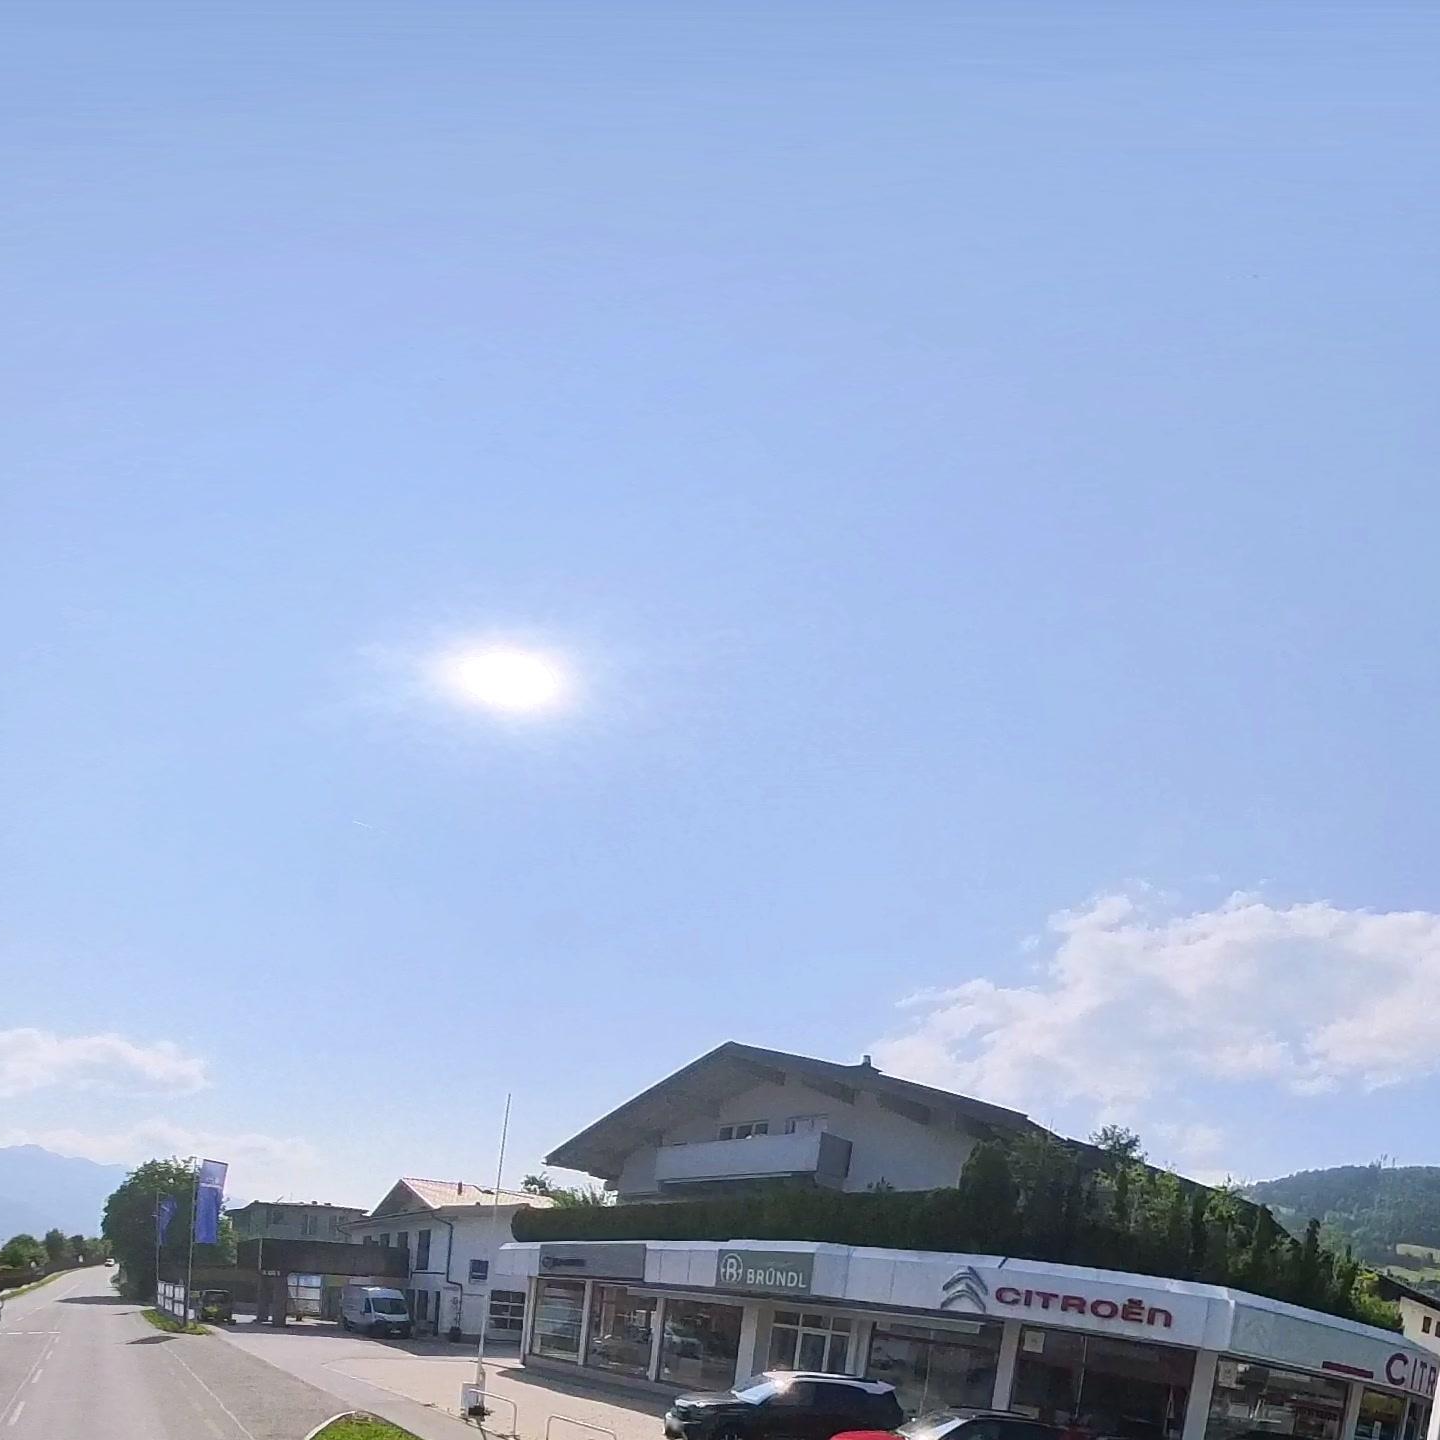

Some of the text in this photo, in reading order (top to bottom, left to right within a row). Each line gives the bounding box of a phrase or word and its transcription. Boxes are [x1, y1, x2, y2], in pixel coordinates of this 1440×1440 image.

[746, 1267, 808, 1289] BRÜNDL
[994, 1286, 1173, 1329] CITROËN
[1385, 1352, 1437, 1395] CITR
